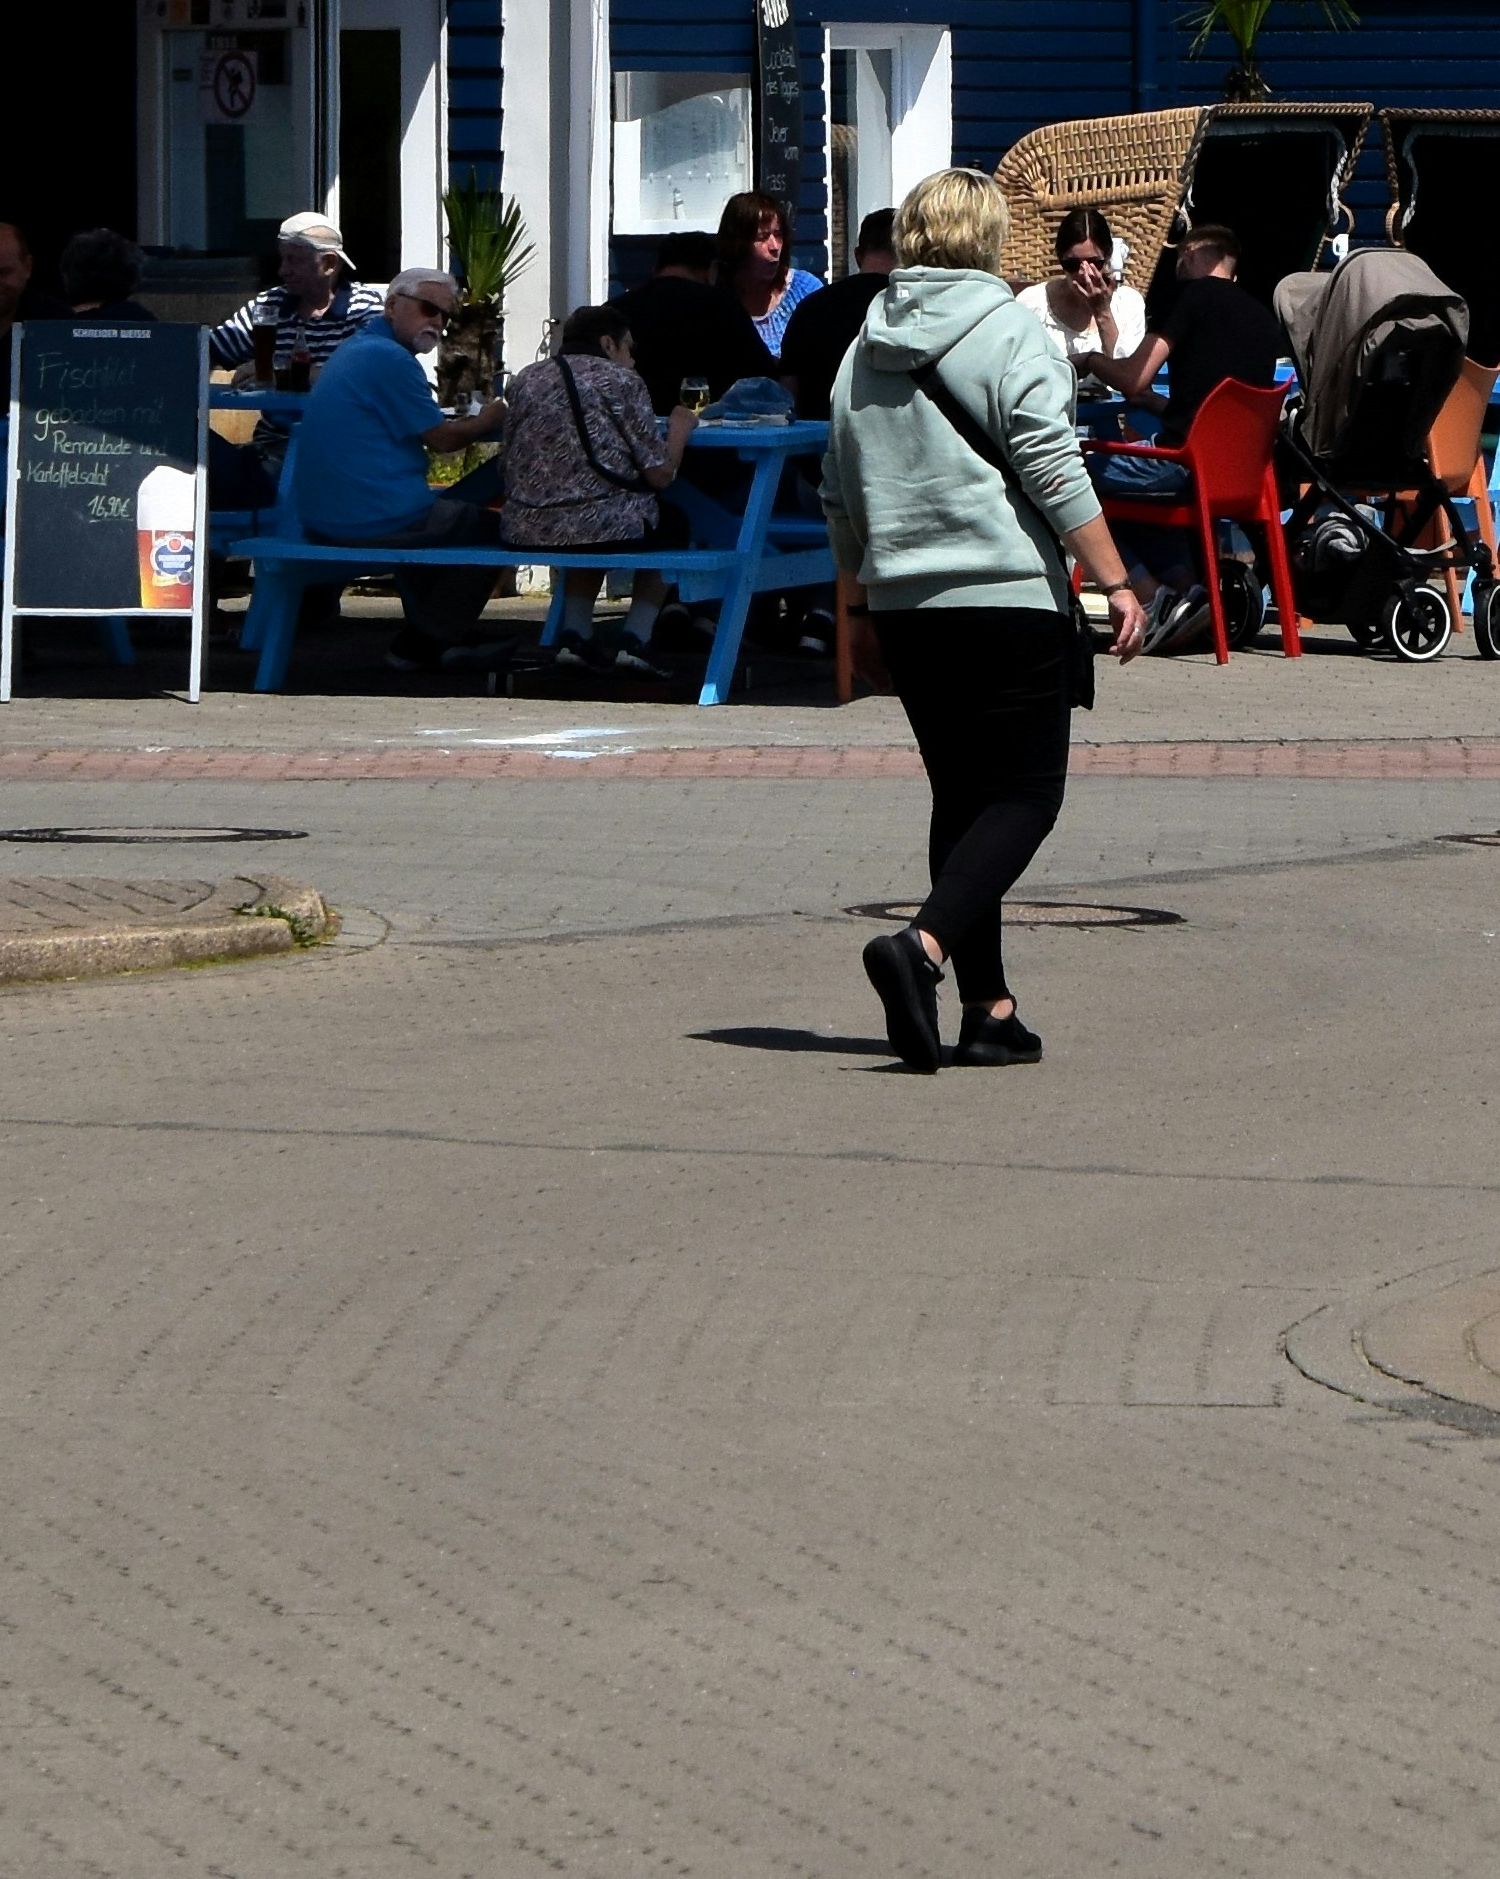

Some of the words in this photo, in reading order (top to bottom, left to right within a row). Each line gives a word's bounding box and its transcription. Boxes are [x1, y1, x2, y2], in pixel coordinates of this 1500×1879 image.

[52, 429, 132, 455] Remoulade
[27, 460, 110, 488] Kartoffelsalat
[88, 495, 131, 519] 16,90€
